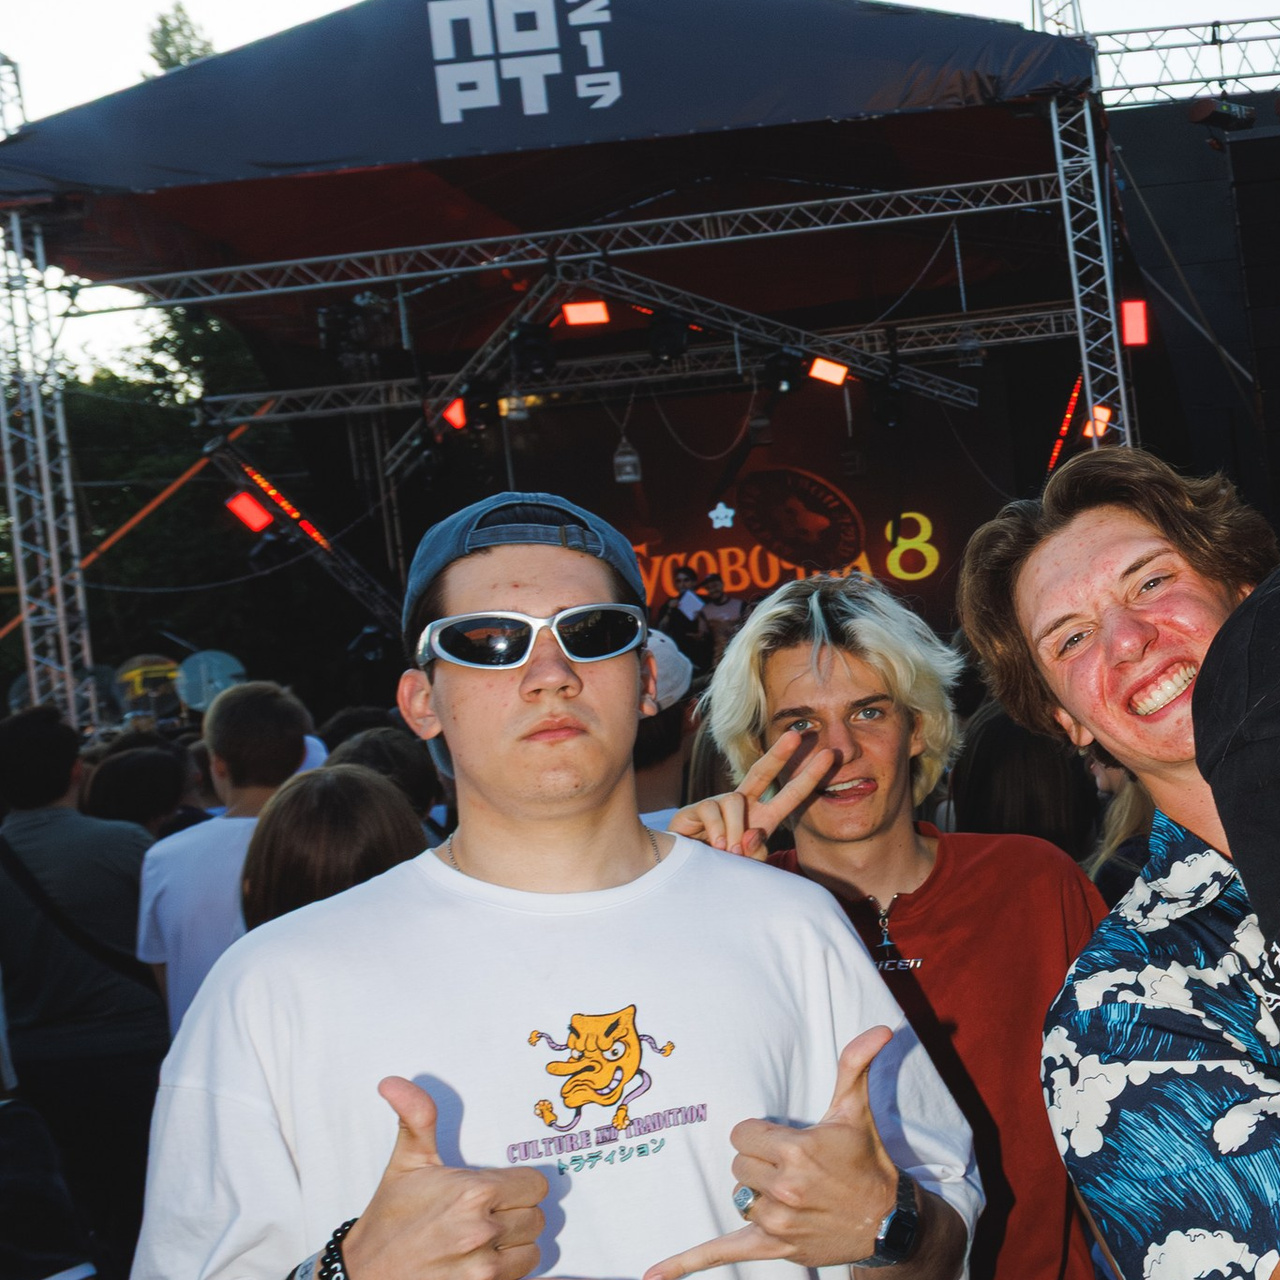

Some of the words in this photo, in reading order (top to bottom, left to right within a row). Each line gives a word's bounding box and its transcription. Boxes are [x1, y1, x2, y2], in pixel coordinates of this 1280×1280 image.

[884, 512, 940, 581] 8
[507, 1130, 592, 1164] CULTURE
[625, 1104, 707, 1139] TRADITION
[558, 1138, 665, 1176] トラディション
